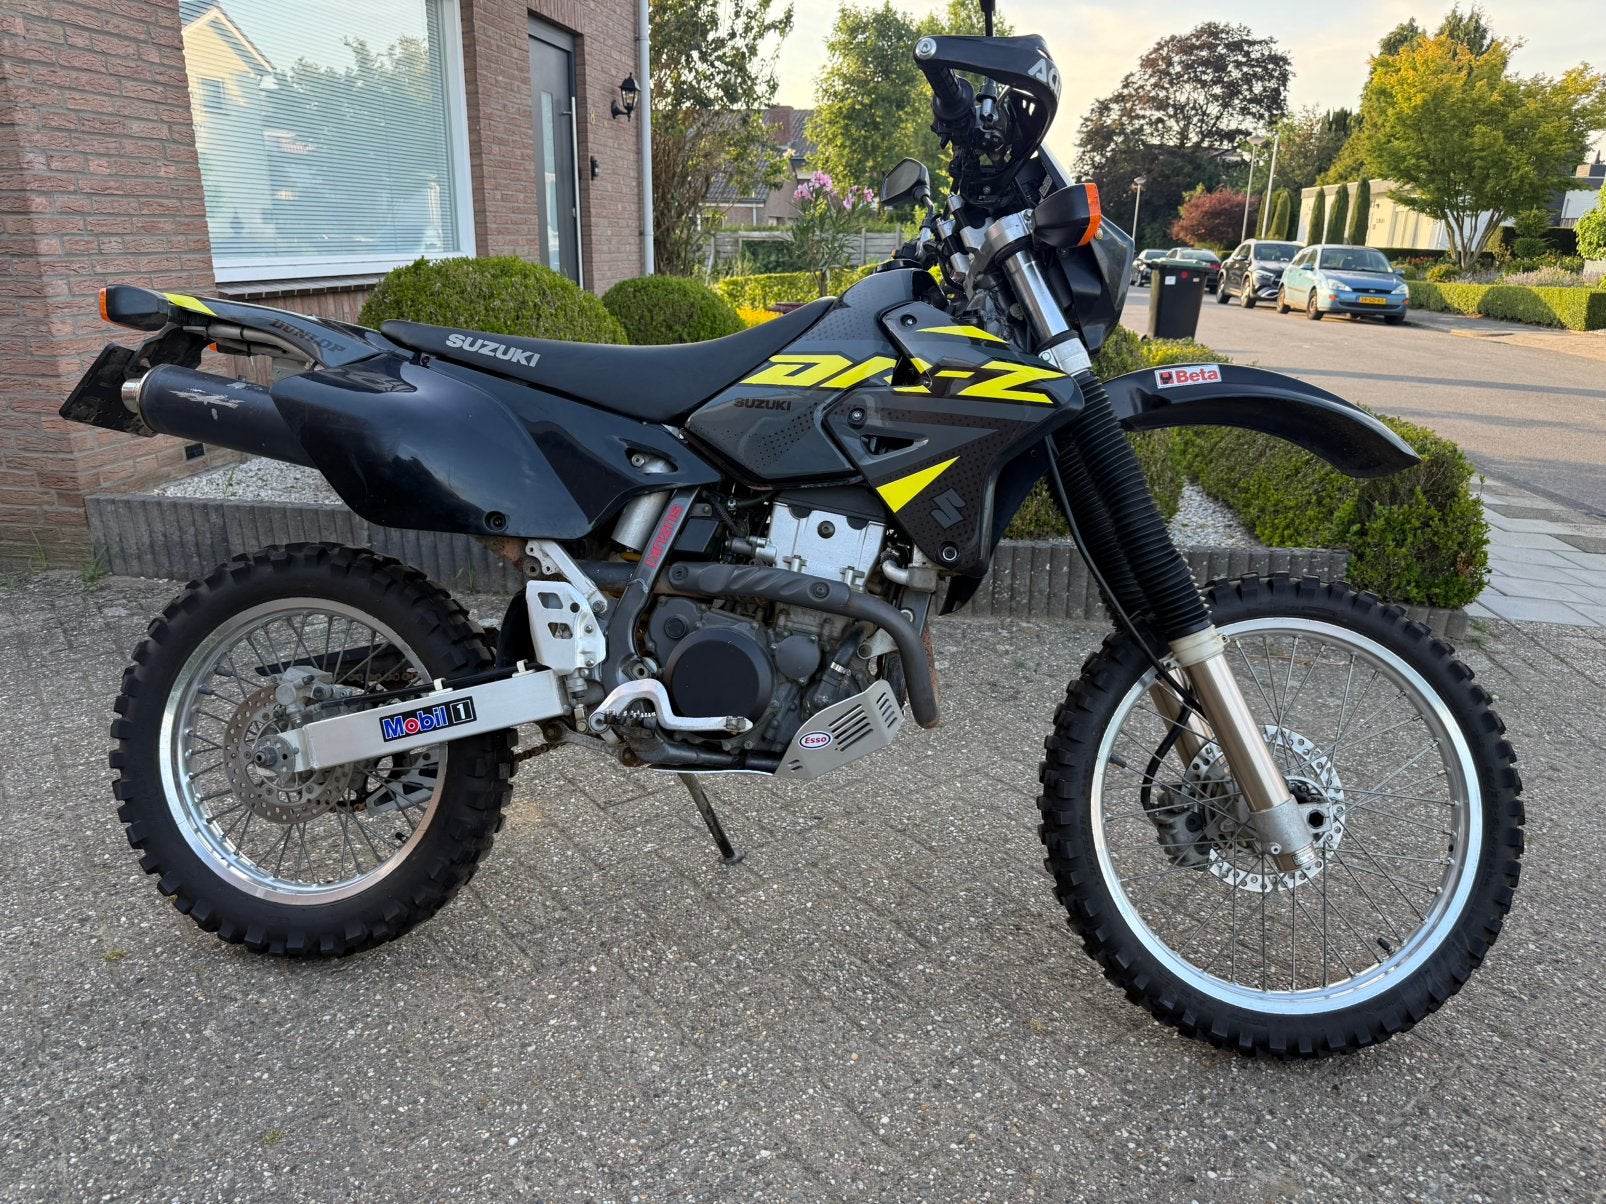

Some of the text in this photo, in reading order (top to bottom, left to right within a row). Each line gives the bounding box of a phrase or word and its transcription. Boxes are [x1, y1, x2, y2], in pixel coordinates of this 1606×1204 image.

[271, 320, 346, 352] DUNLOP
[445, 333, 541, 368] SUZUKI
[1175, 368, 1219, 384] Beta
[734, 398, 792, 411] SUZUKI
[645, 504, 683, 569] SUZUKI
[382, 705, 449, 740] Mobil
